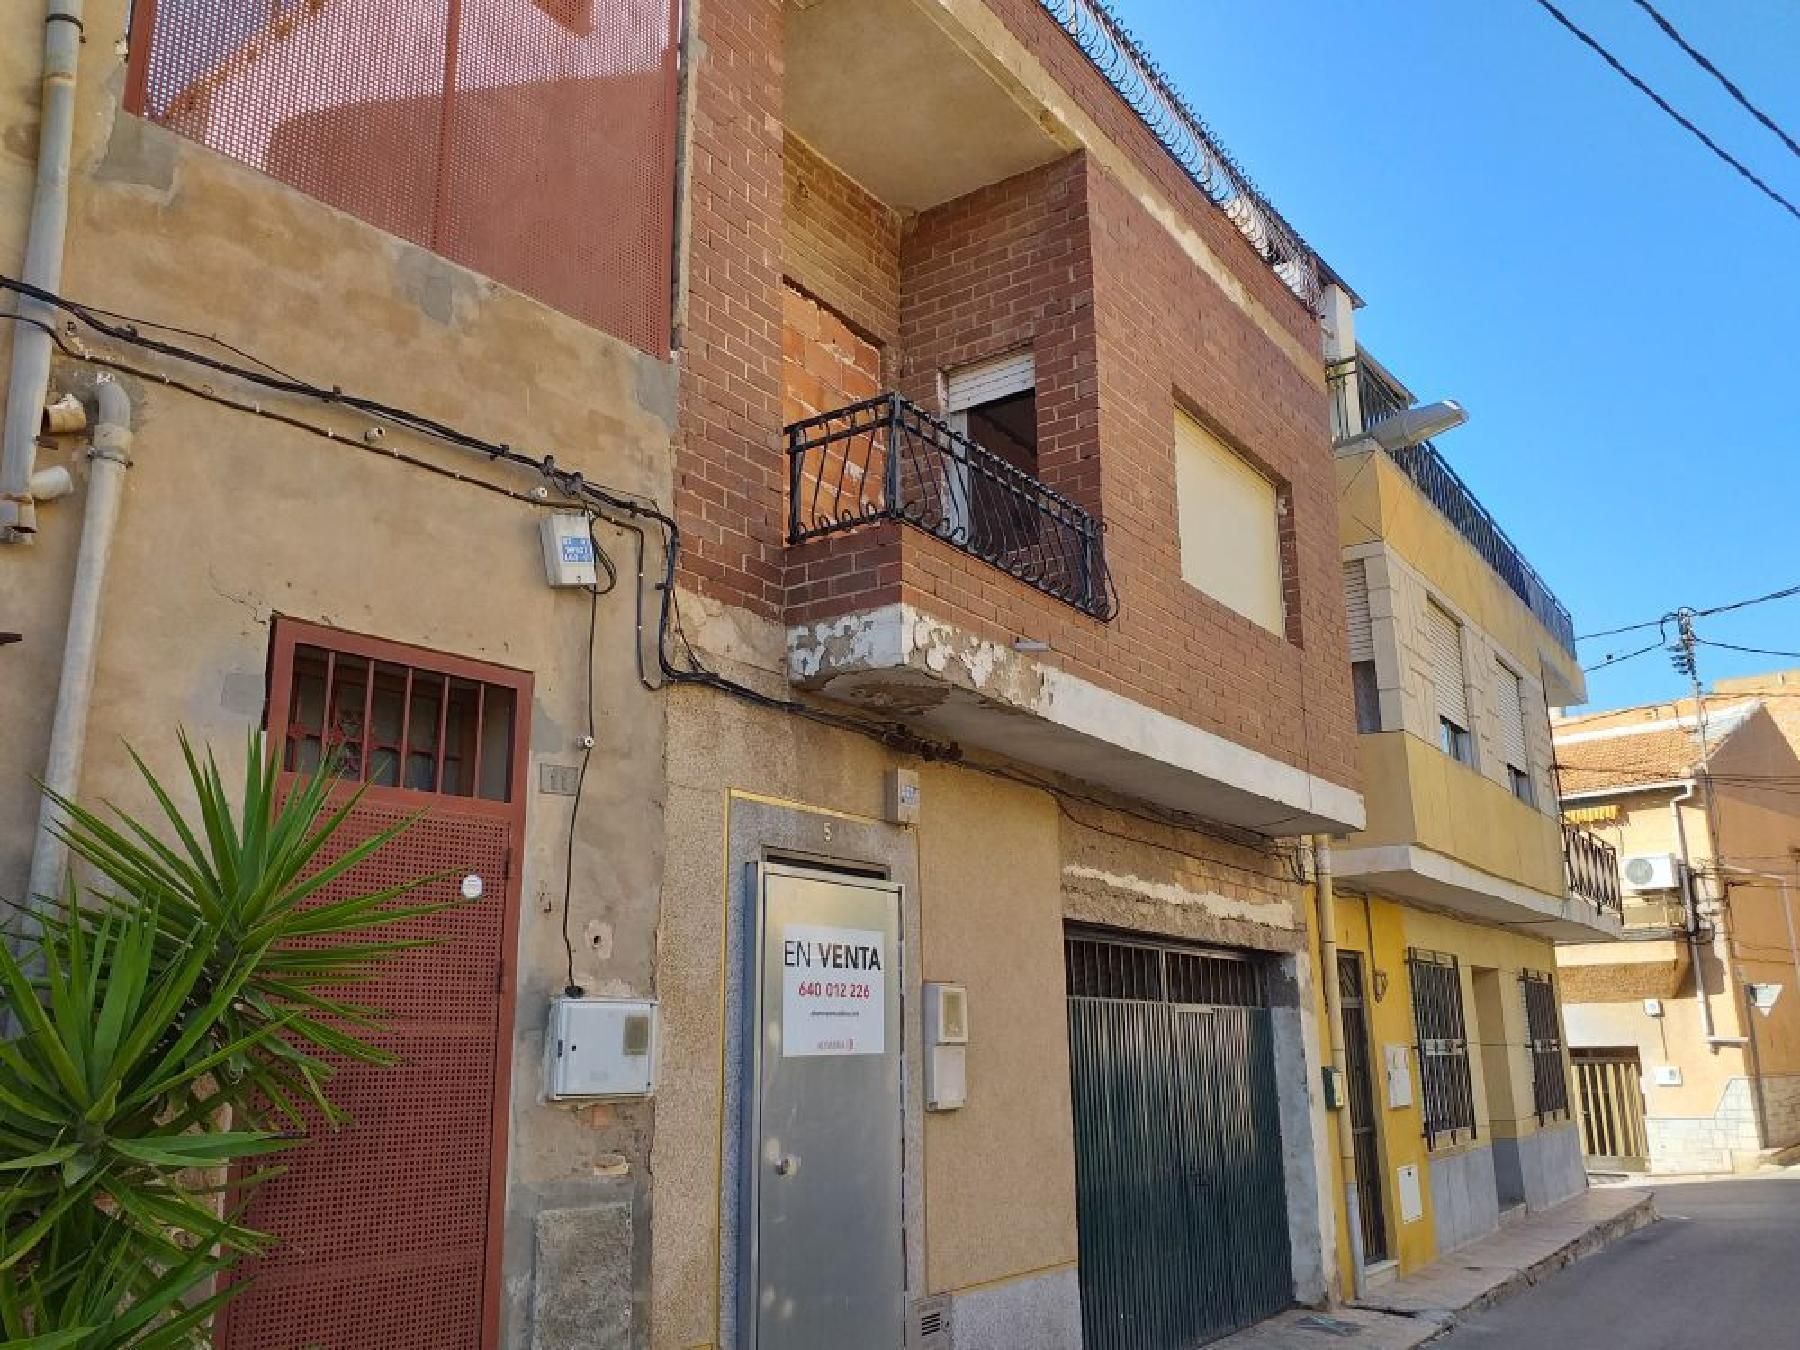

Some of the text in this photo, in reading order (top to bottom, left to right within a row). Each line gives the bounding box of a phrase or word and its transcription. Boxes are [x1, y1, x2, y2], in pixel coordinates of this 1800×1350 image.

[823, 822, 833, 843] 5
[784, 940, 881, 970] EN VENTA
[799, 982, 870, 1000] 640 012 226
